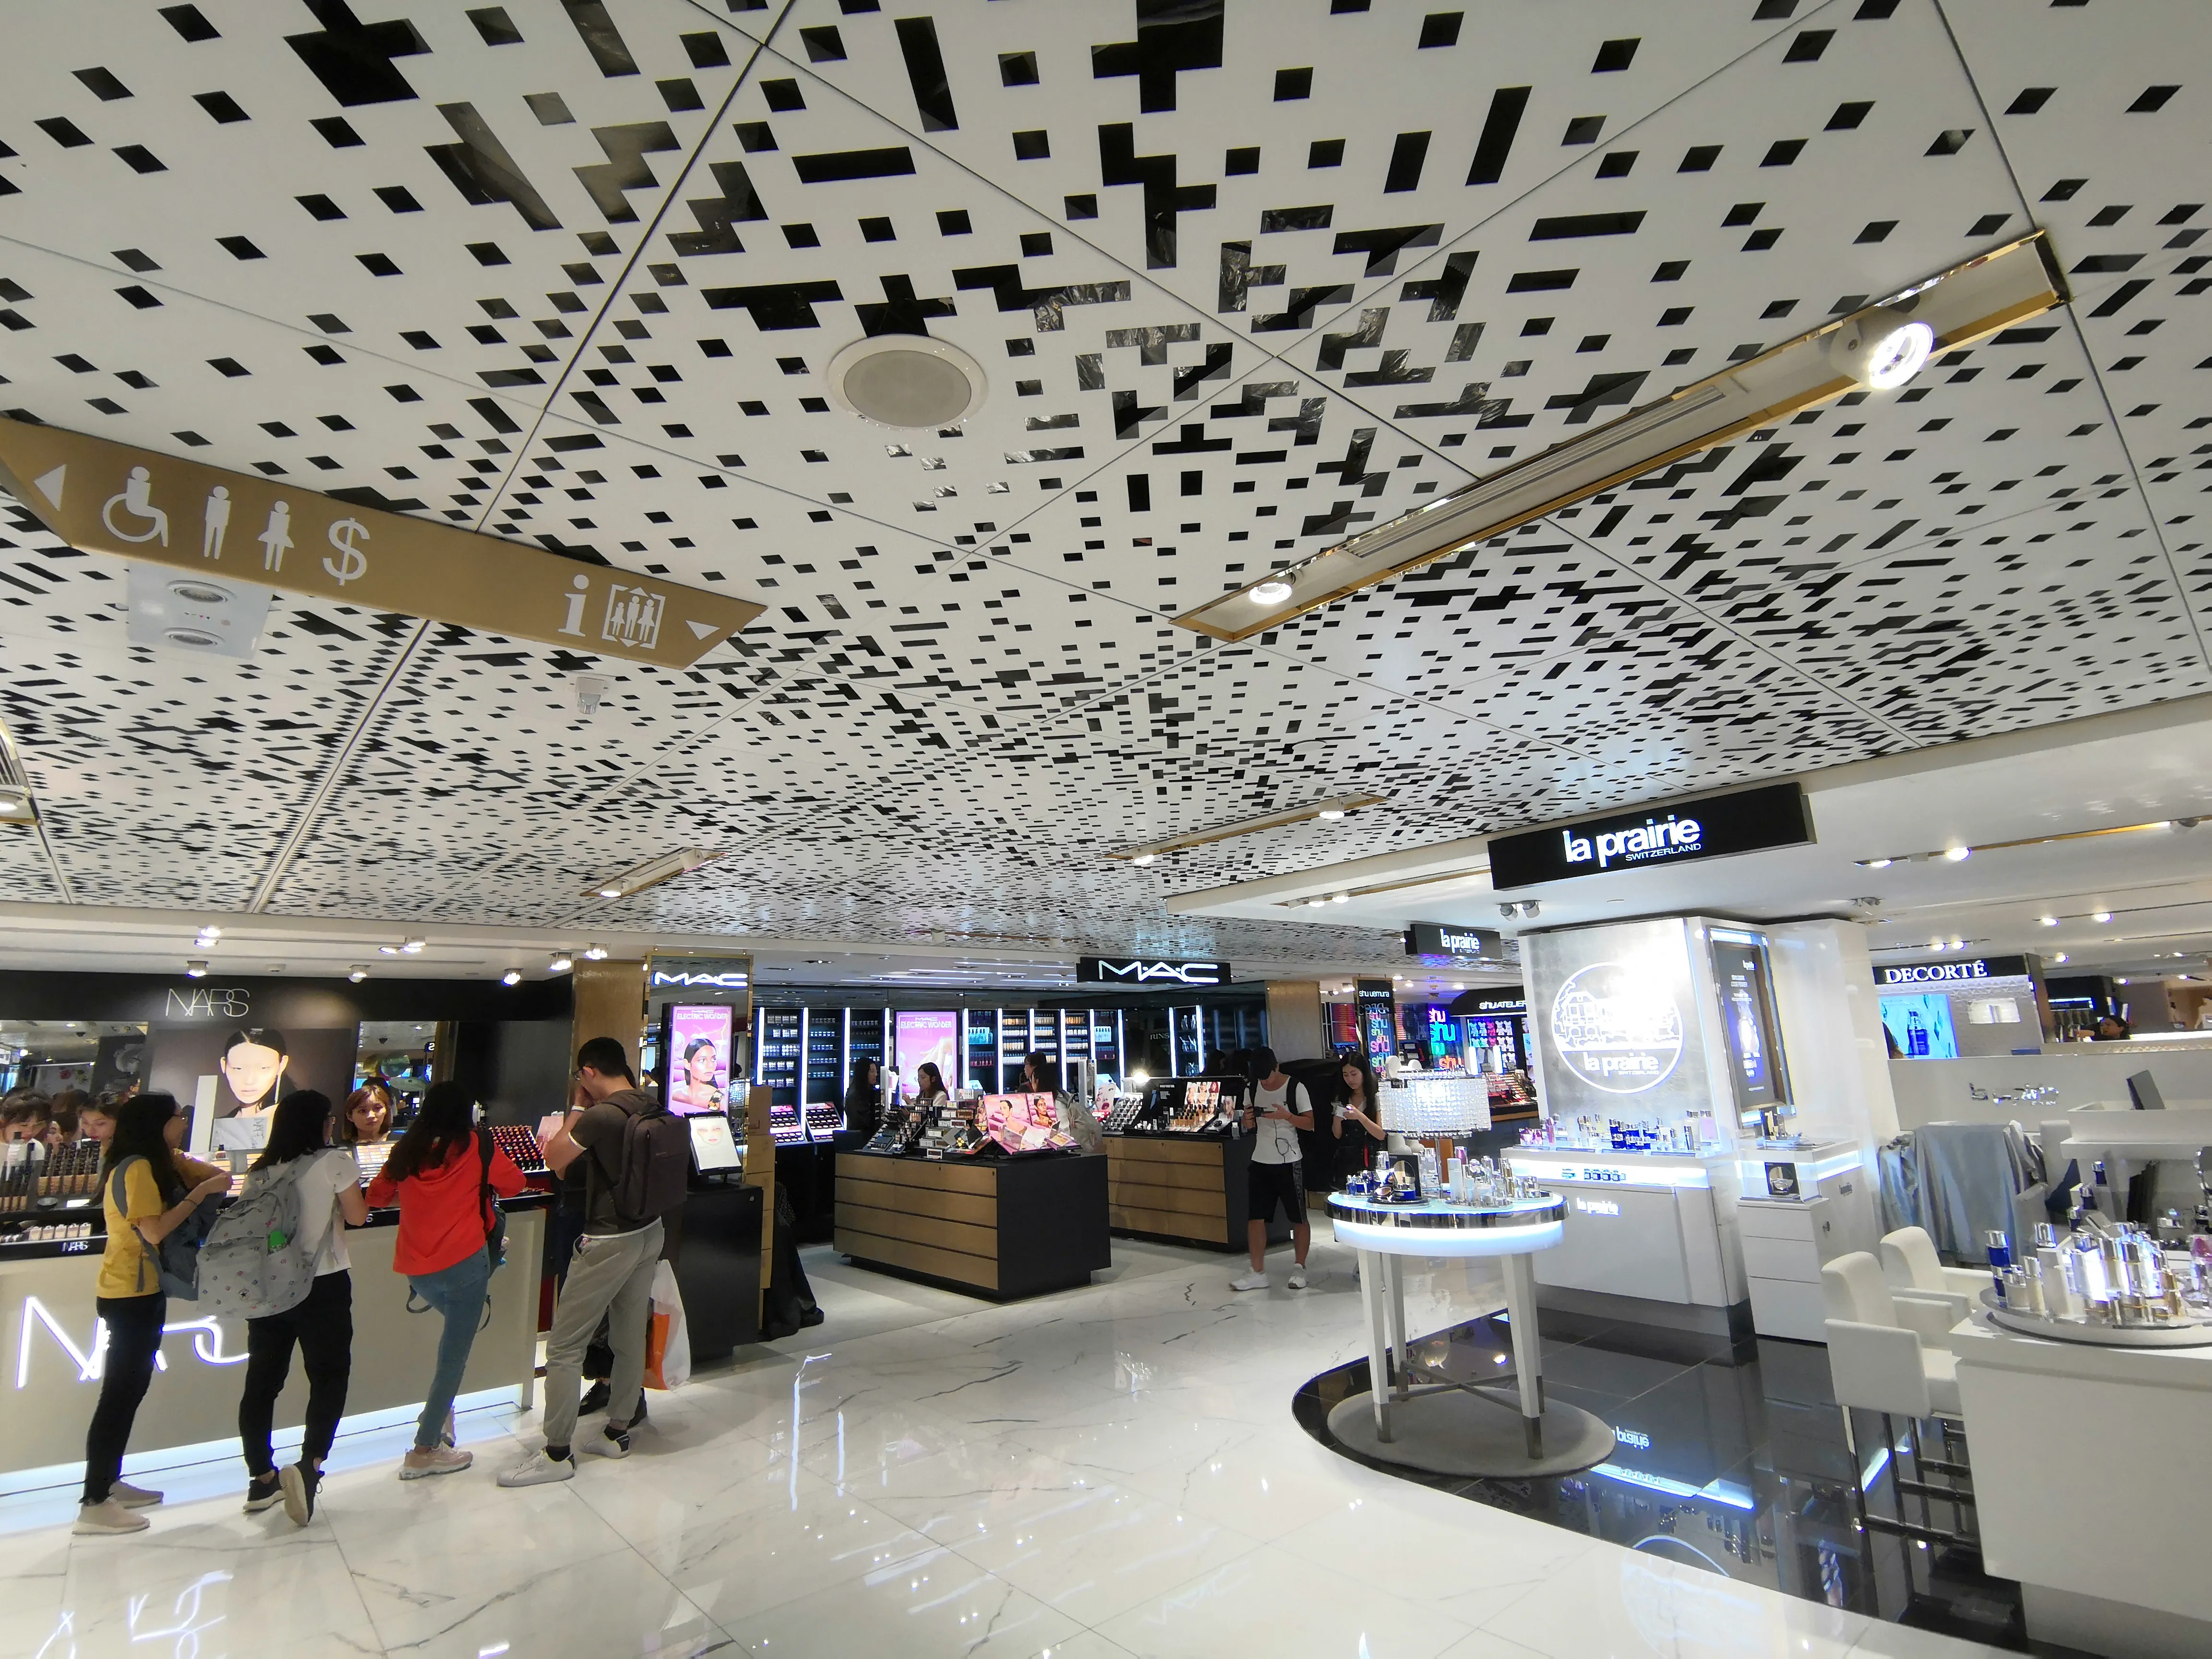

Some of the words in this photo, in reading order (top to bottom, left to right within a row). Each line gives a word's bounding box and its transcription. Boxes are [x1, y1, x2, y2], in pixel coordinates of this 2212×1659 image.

[1563, 830, 1592, 863] la
[1596, 814, 1701, 868] prairie
[1625, 843, 1702, 862] SWITZERLAND
[1440, 928, 1451, 948] la
[1450, 932, 1480, 954] prairie
[1884, 960, 1988, 984] DECORTÉ
[165, 988, 250, 1017] NARS
[1358, 989, 1369, 998] shu
[1583, 1051, 1600, 1070] la
[1601, 1052, 1659, 1077] prairie
